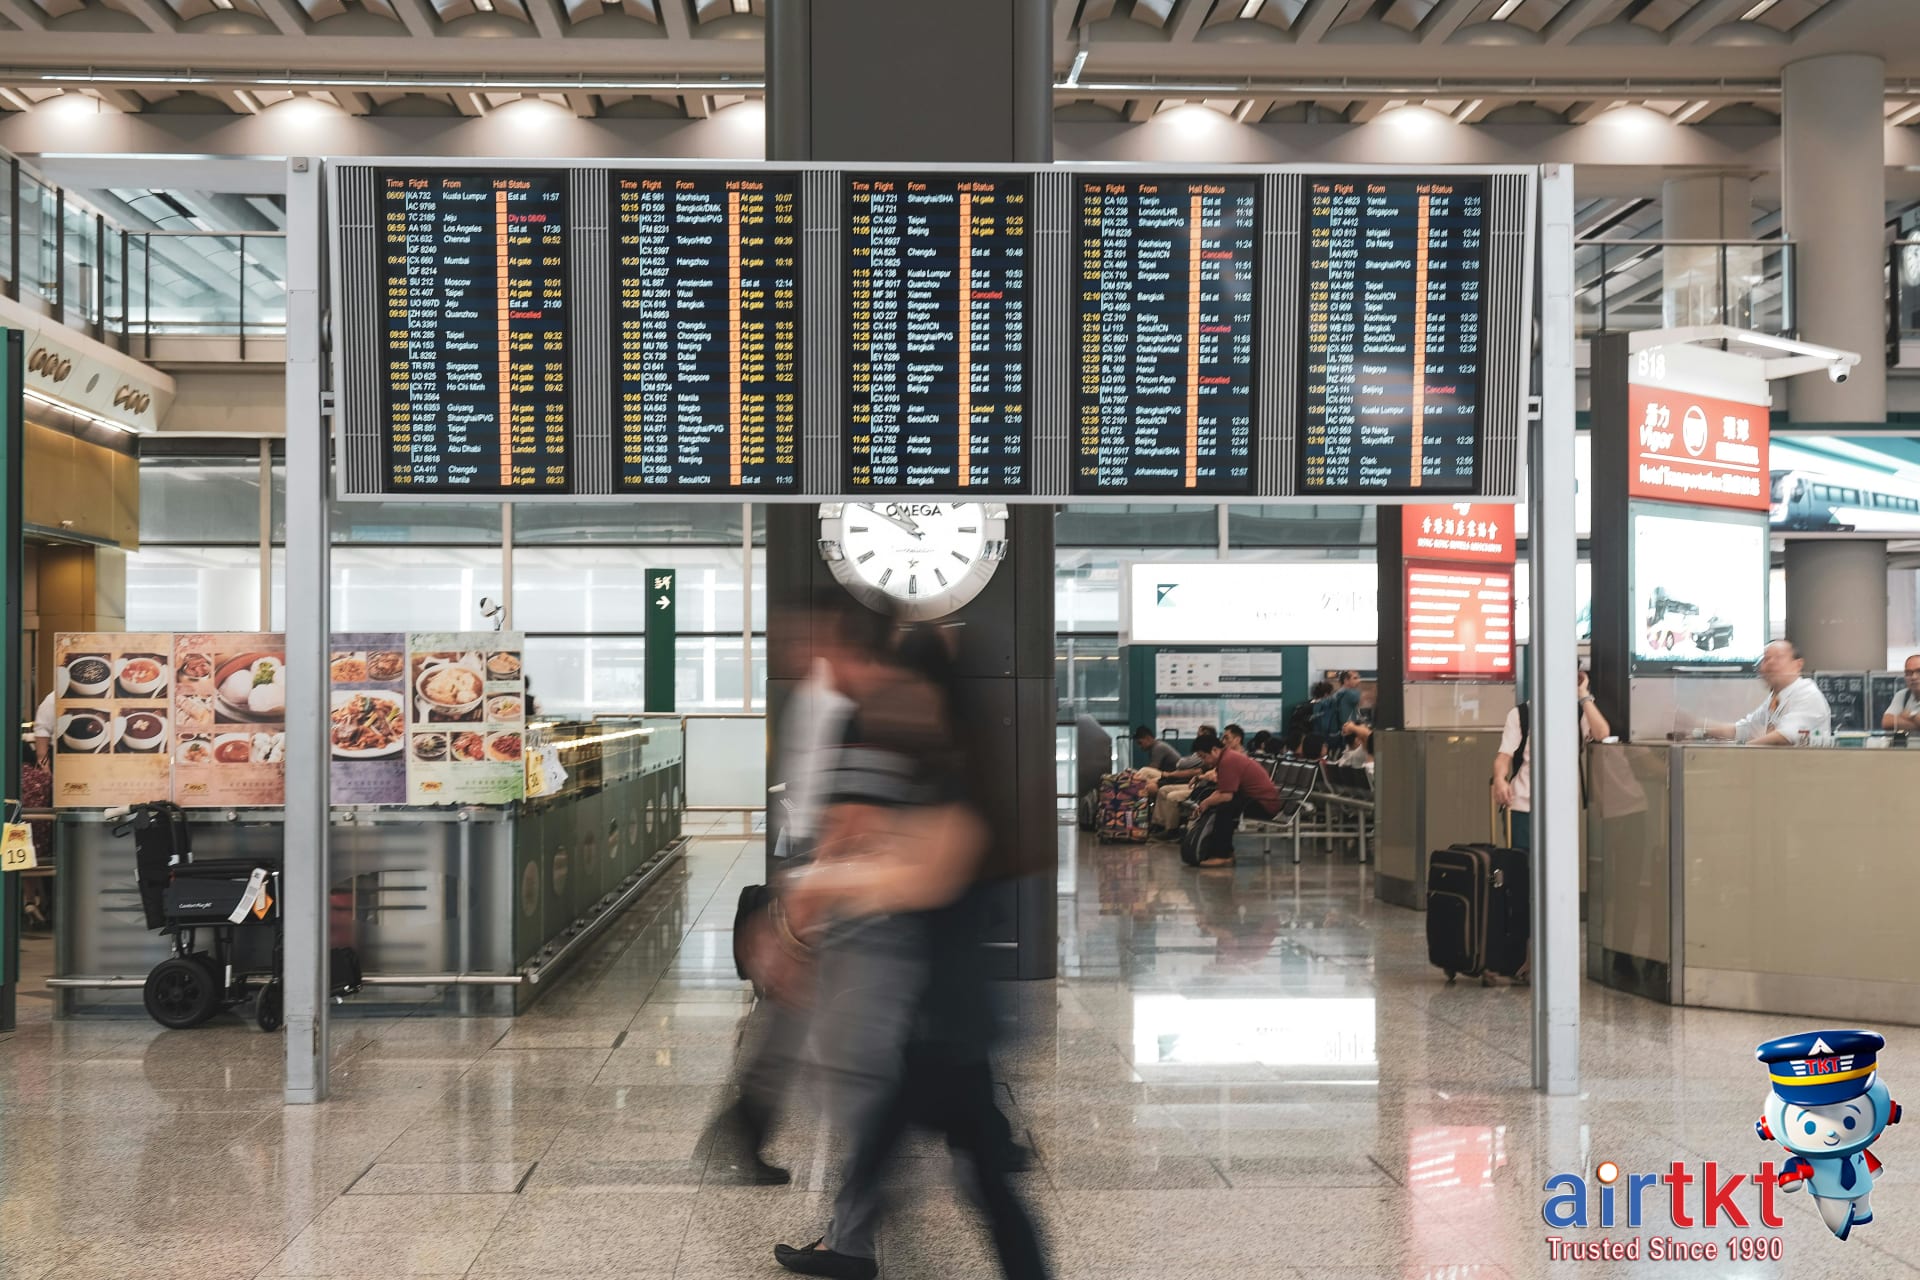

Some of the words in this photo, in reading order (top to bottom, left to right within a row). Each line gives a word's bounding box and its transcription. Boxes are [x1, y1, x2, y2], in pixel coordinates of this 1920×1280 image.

[386, 179, 404, 187] Time
[409, 179, 428, 189] Flight
[443, 179, 461, 188] From
[493, 180, 507, 188] Hall
[508, 180, 530, 188] Status
[621, 180, 637, 189] Time
[642, 180, 661, 190] Flight
[676, 180, 694, 189] From
[726, 181, 740, 189] Hall
[741, 181, 763, 190] Status
[853, 182, 869, 190] Time
[875, 182, 893, 192] Flight
[908, 182, 926, 191] From
[958, 183, 971, 191] Hall
[973, 182, 994, 191] Status
[1085, 184, 1101, 193] Time
[1106, 184, 1125, 194] Flight
[1139, 184, 1157, 193] From
[1189, 185, 1202, 193] Hall
[1203, 185, 1225, 193] Status
[1313, 184, 1330, 193] Time
[1335, 184, 1353, 195] Flight
[1368, 184, 1385, 193] From
[1417, 185, 1430, 193] Hall
[1431, 185, 1453, 193] Status
[443, 192, 461, 200] Kuala
[462, 192, 487, 201] Lumpur
[676, 193, 709, 203] Kaohsiung
[749, 195, 763, 203] gate
[980, 196, 994, 204] gate
[749, 205, 763, 214] gate
[1367, 207, 1398, 217] Singapore
[443, 214, 457, 223] Jeju
[749, 216, 763, 224] gate
[908, 216, 926, 225] Taipei
[980, 217, 994, 226] gate
[456, 224, 482, 234] Angeles
[908, 226, 929, 236] Beijing
[444, 235, 470, 243] Chennai
[517, 237, 531, 245] gate
[1376, 239, 1393, 249] Nang
[908, 248, 936, 258] Chengdu
[517, 258, 532, 266] gate
[677, 258, 709, 267] Hangzhou
[908, 269, 926, 277] Kuala
[927, 269, 951, 279] Lumpur
[445, 278, 471, 286] Moscow
[677, 279, 713, 287] Amsterdam
[907, 280, 940, 288] Quanzhou
[445, 288, 463, 298] Taipei
[445, 299, 459, 309] Jeju
[677, 300, 704, 310] Bangkok
[908, 301, 939, 311] Singapore
[445, 310, 478, 318] Quanzhou
[677, 321, 706, 331] Chengdu
[678, 352, 696, 360] Dubai
[446, 362, 478, 371] Singapore
[1638, 349, 1666, 381] B18
[1639, 425, 1674, 452] Vigor
[1837, 692, 1857, 705] City
[7, 848, 26, 865] 19
